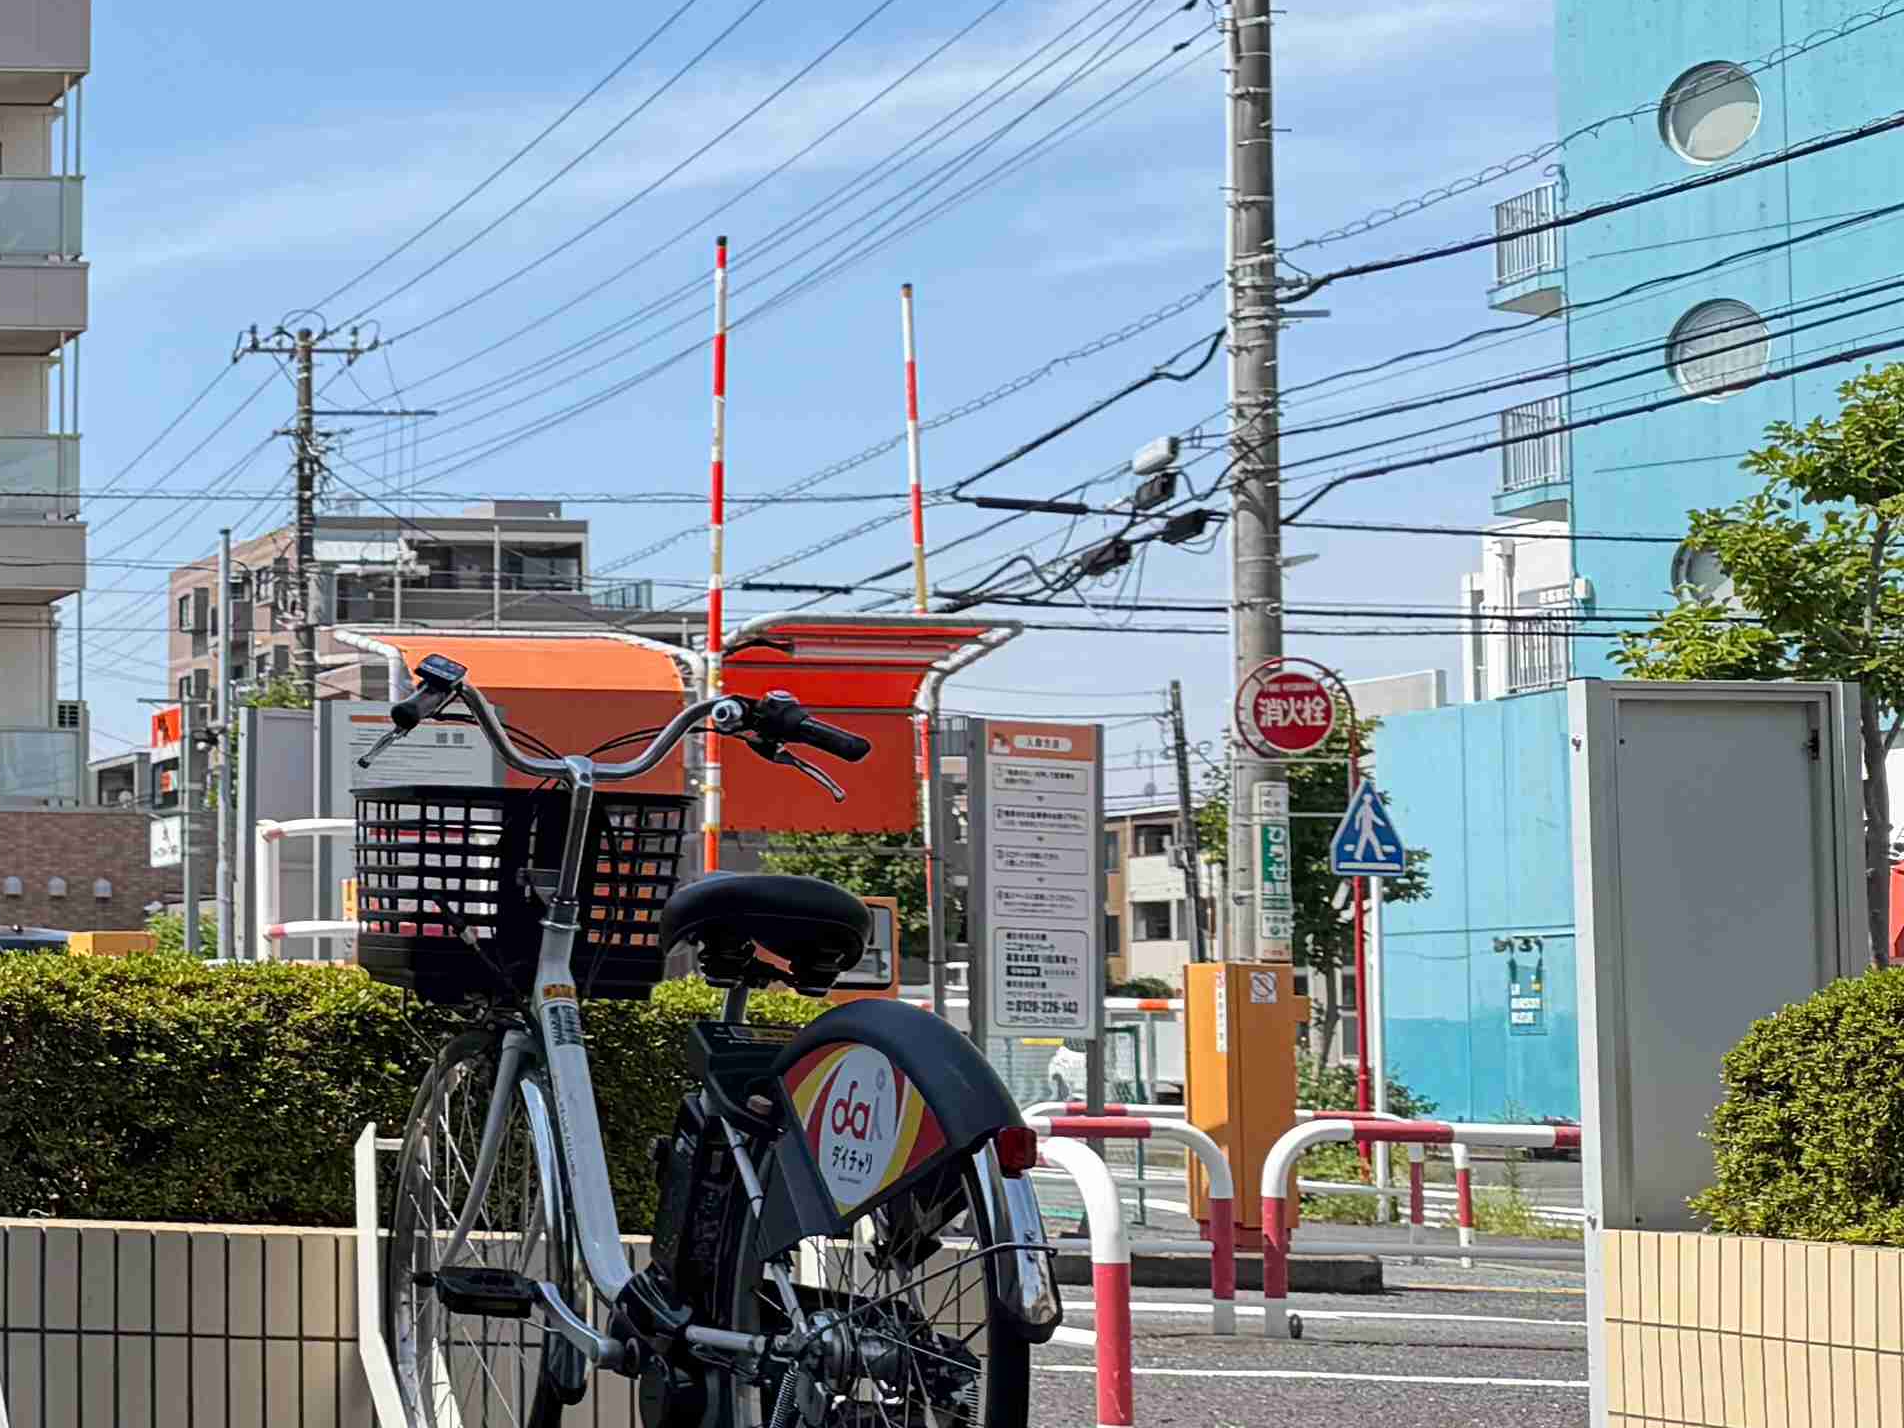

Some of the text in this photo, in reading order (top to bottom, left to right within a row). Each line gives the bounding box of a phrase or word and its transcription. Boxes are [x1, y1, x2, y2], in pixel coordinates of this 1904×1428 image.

[1257, 696, 1328, 727] 消火栓
[832, 1145, 873, 1174] ダイチャリ
